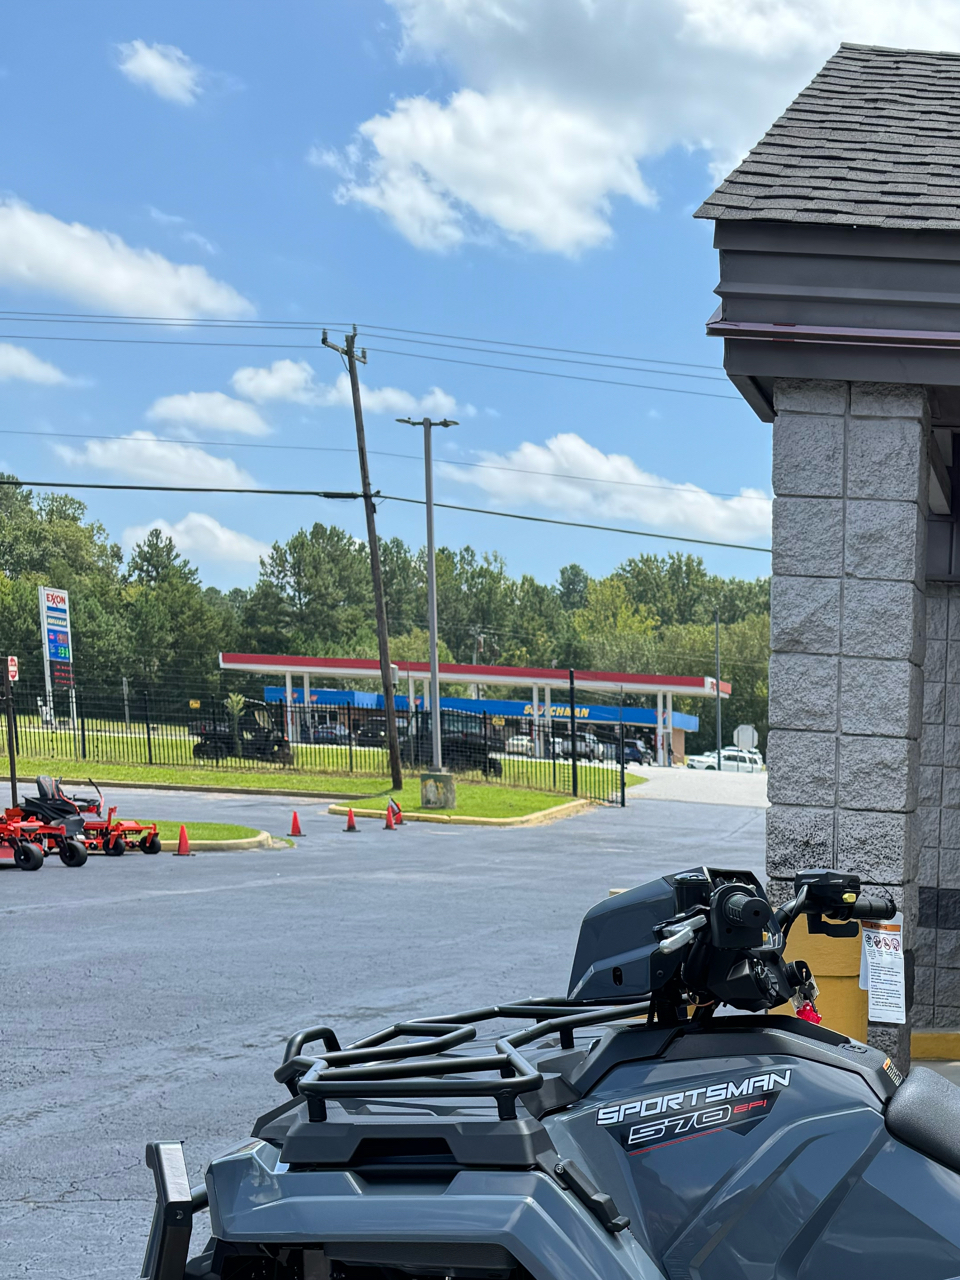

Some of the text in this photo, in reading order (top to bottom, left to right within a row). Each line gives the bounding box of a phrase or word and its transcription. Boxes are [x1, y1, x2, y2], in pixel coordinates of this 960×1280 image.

[46, 593, 66, 607] EXXON
[597, 1070, 791, 1125] SPORTSMAN
[628, 1100, 768, 1145] 570 EFI
